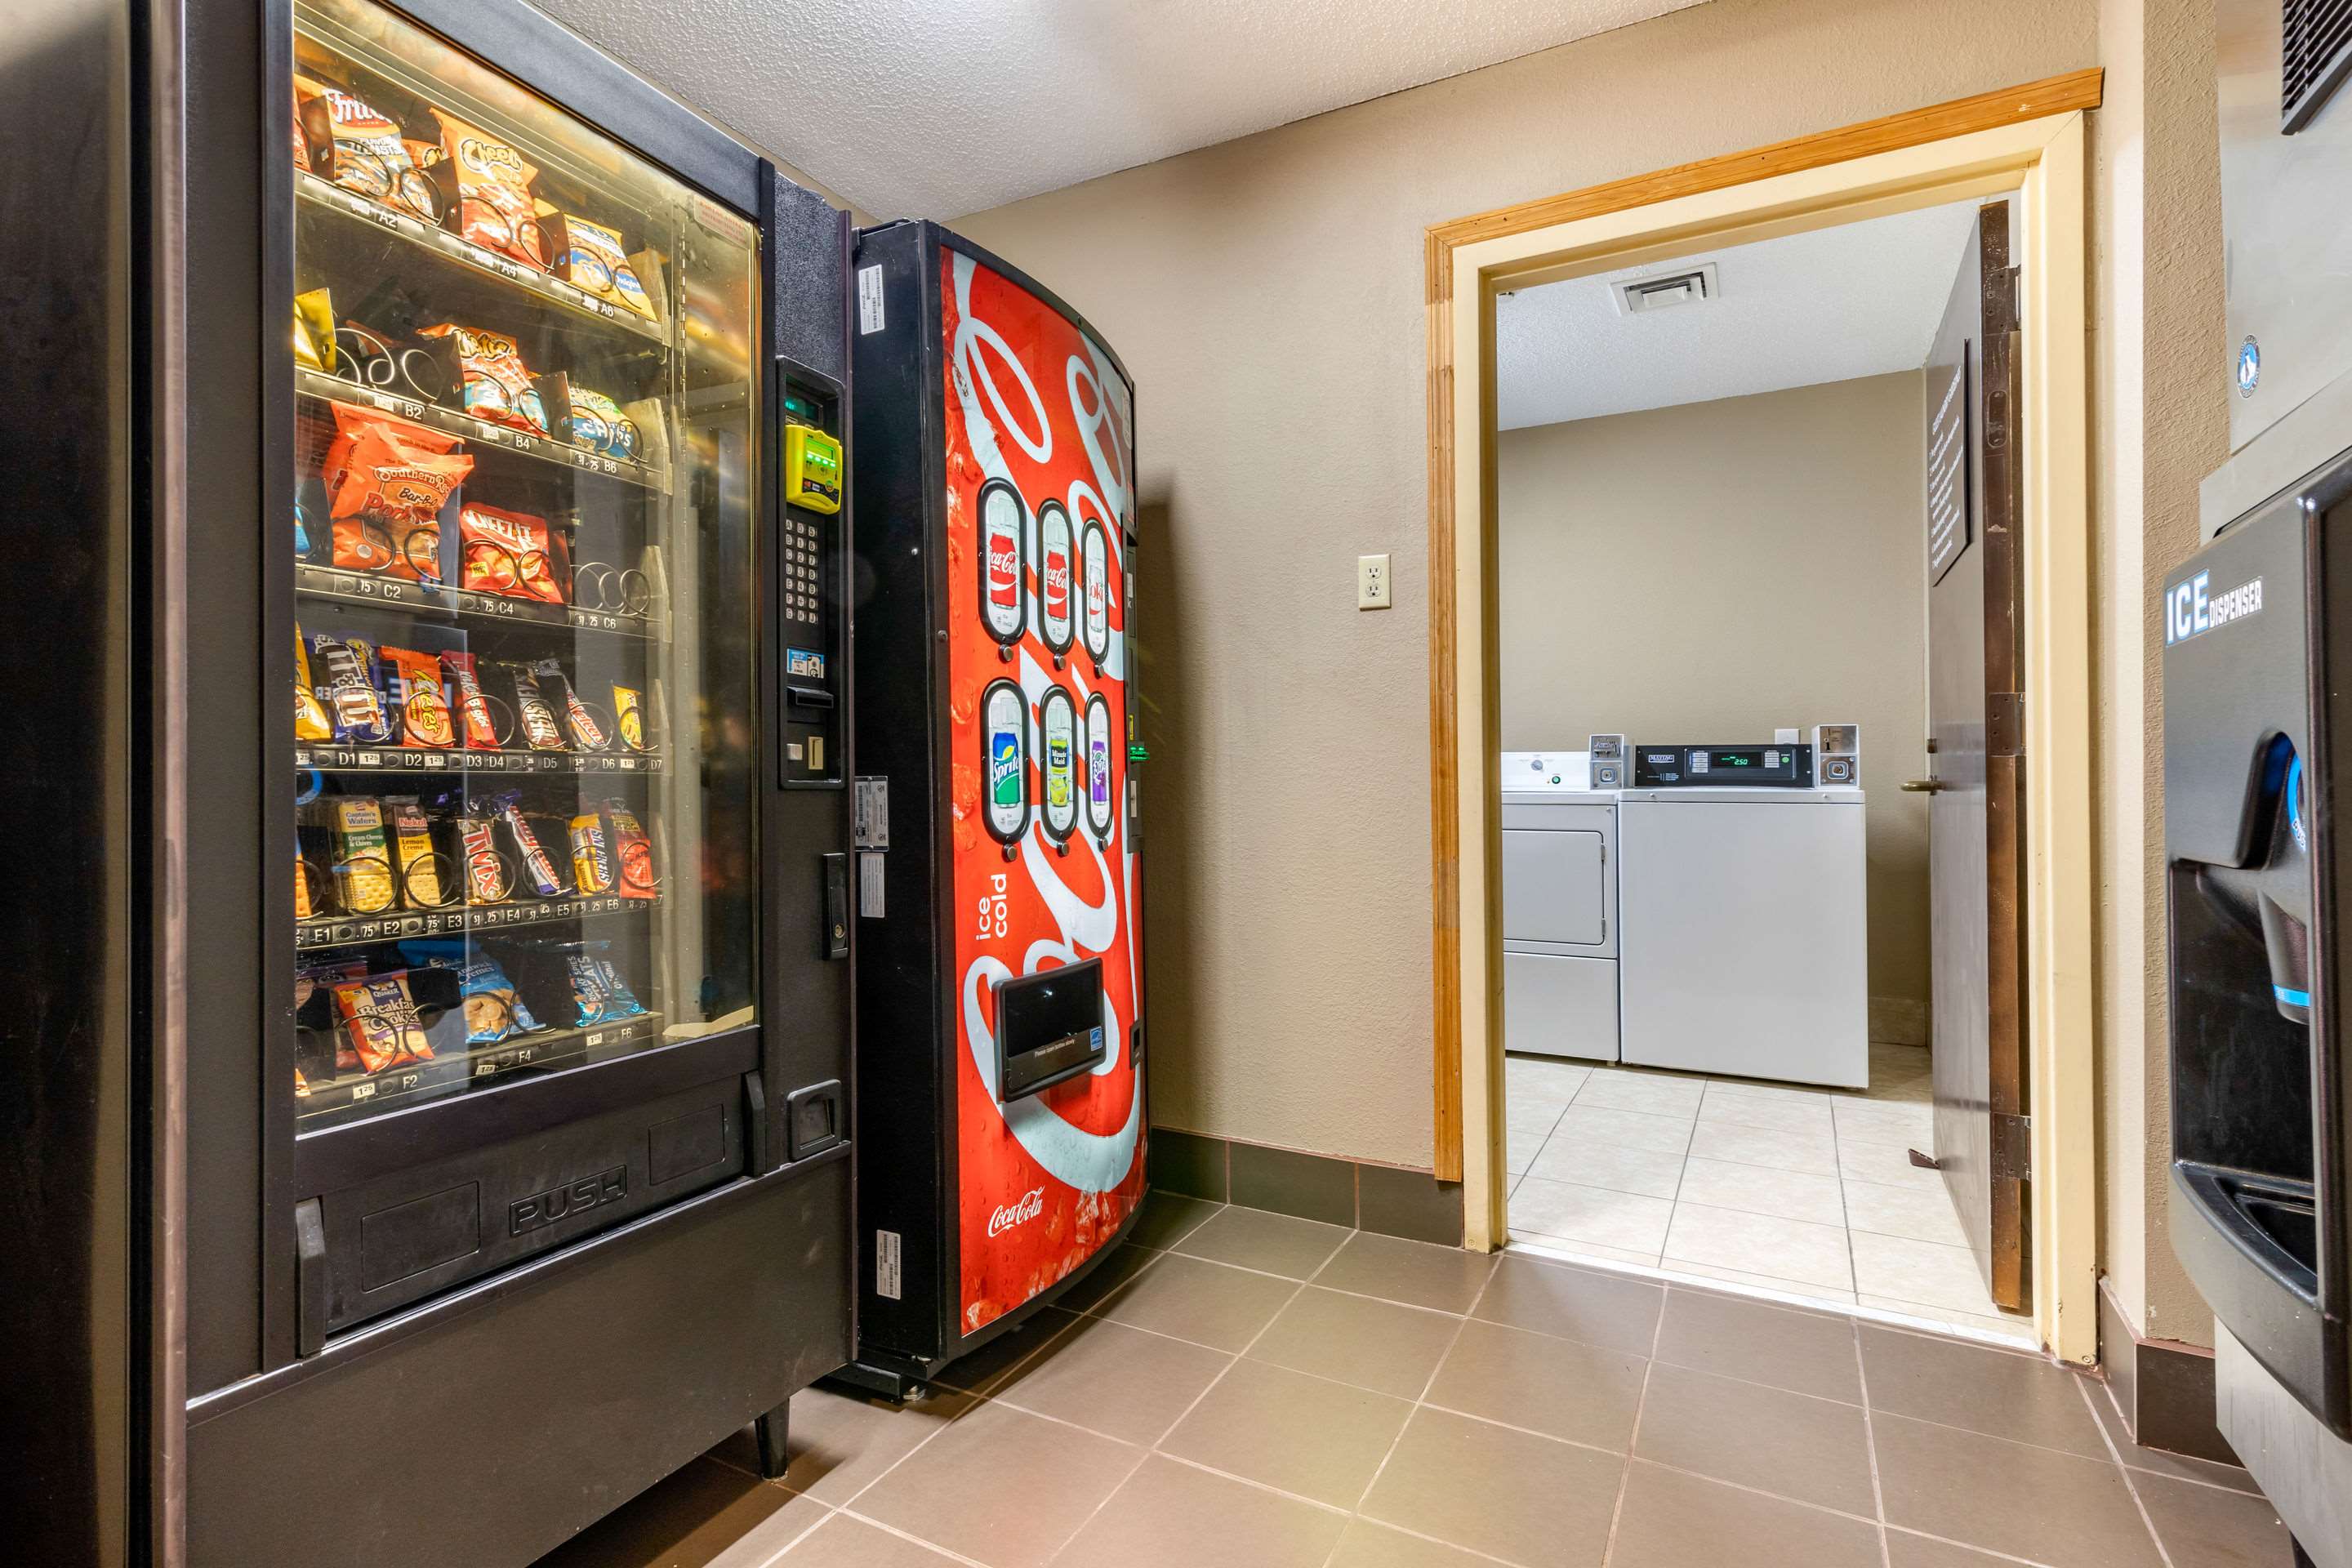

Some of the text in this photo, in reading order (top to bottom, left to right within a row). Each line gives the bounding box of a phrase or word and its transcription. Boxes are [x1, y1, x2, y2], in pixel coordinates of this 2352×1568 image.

[321, 87, 393, 125] Frit
[460, 139, 523, 173] Cheetos
[379, 212, 397, 227] A2
[501, 262, 518, 278] A4
[405, 406, 422, 420] B2
[582, 418, 631, 447] CHPS
[515, 435, 530, 449] B4
[604, 461, 617, 473] B6
[384, 585, 401, 599] C2
[499, 603, 514, 614] C4
[2167, 571, 2261, 645] ICE DISPENSER
[604, 618, 616, 629] C6
[339, 753, 355, 765] D1
[405, 755, 422, 766] D2
[467, 755, 482, 768] D3
[489, 756, 504, 768] D4
[544, 757, 557, 768] D5
[603, 758, 615, 769] D6
[651, 759, 662, 769] D7
[1054, 757, 1066, 765] Maid
[557, 904, 569, 916] E5
[607, 899, 618, 910] E6
[991, 874, 1008, 938] cold
[448, 915, 462, 928] E3
[507, 910, 520, 922] E4
[977, 897, 991, 940] ice
[384, 922, 400, 934] E2
[314, 929, 330, 942] E1
[373, 987, 400, 997] QUAKER
[357, 998, 415, 1015] Breakfas
[621, 1027, 632, 1039] F6
[519, 1050, 531, 1063] F4
[403, 1075, 417, 1089] F2
[514, 1176, 626, 1234] PUSH
[987, 1185, 1045, 1238] Coca-Cola
